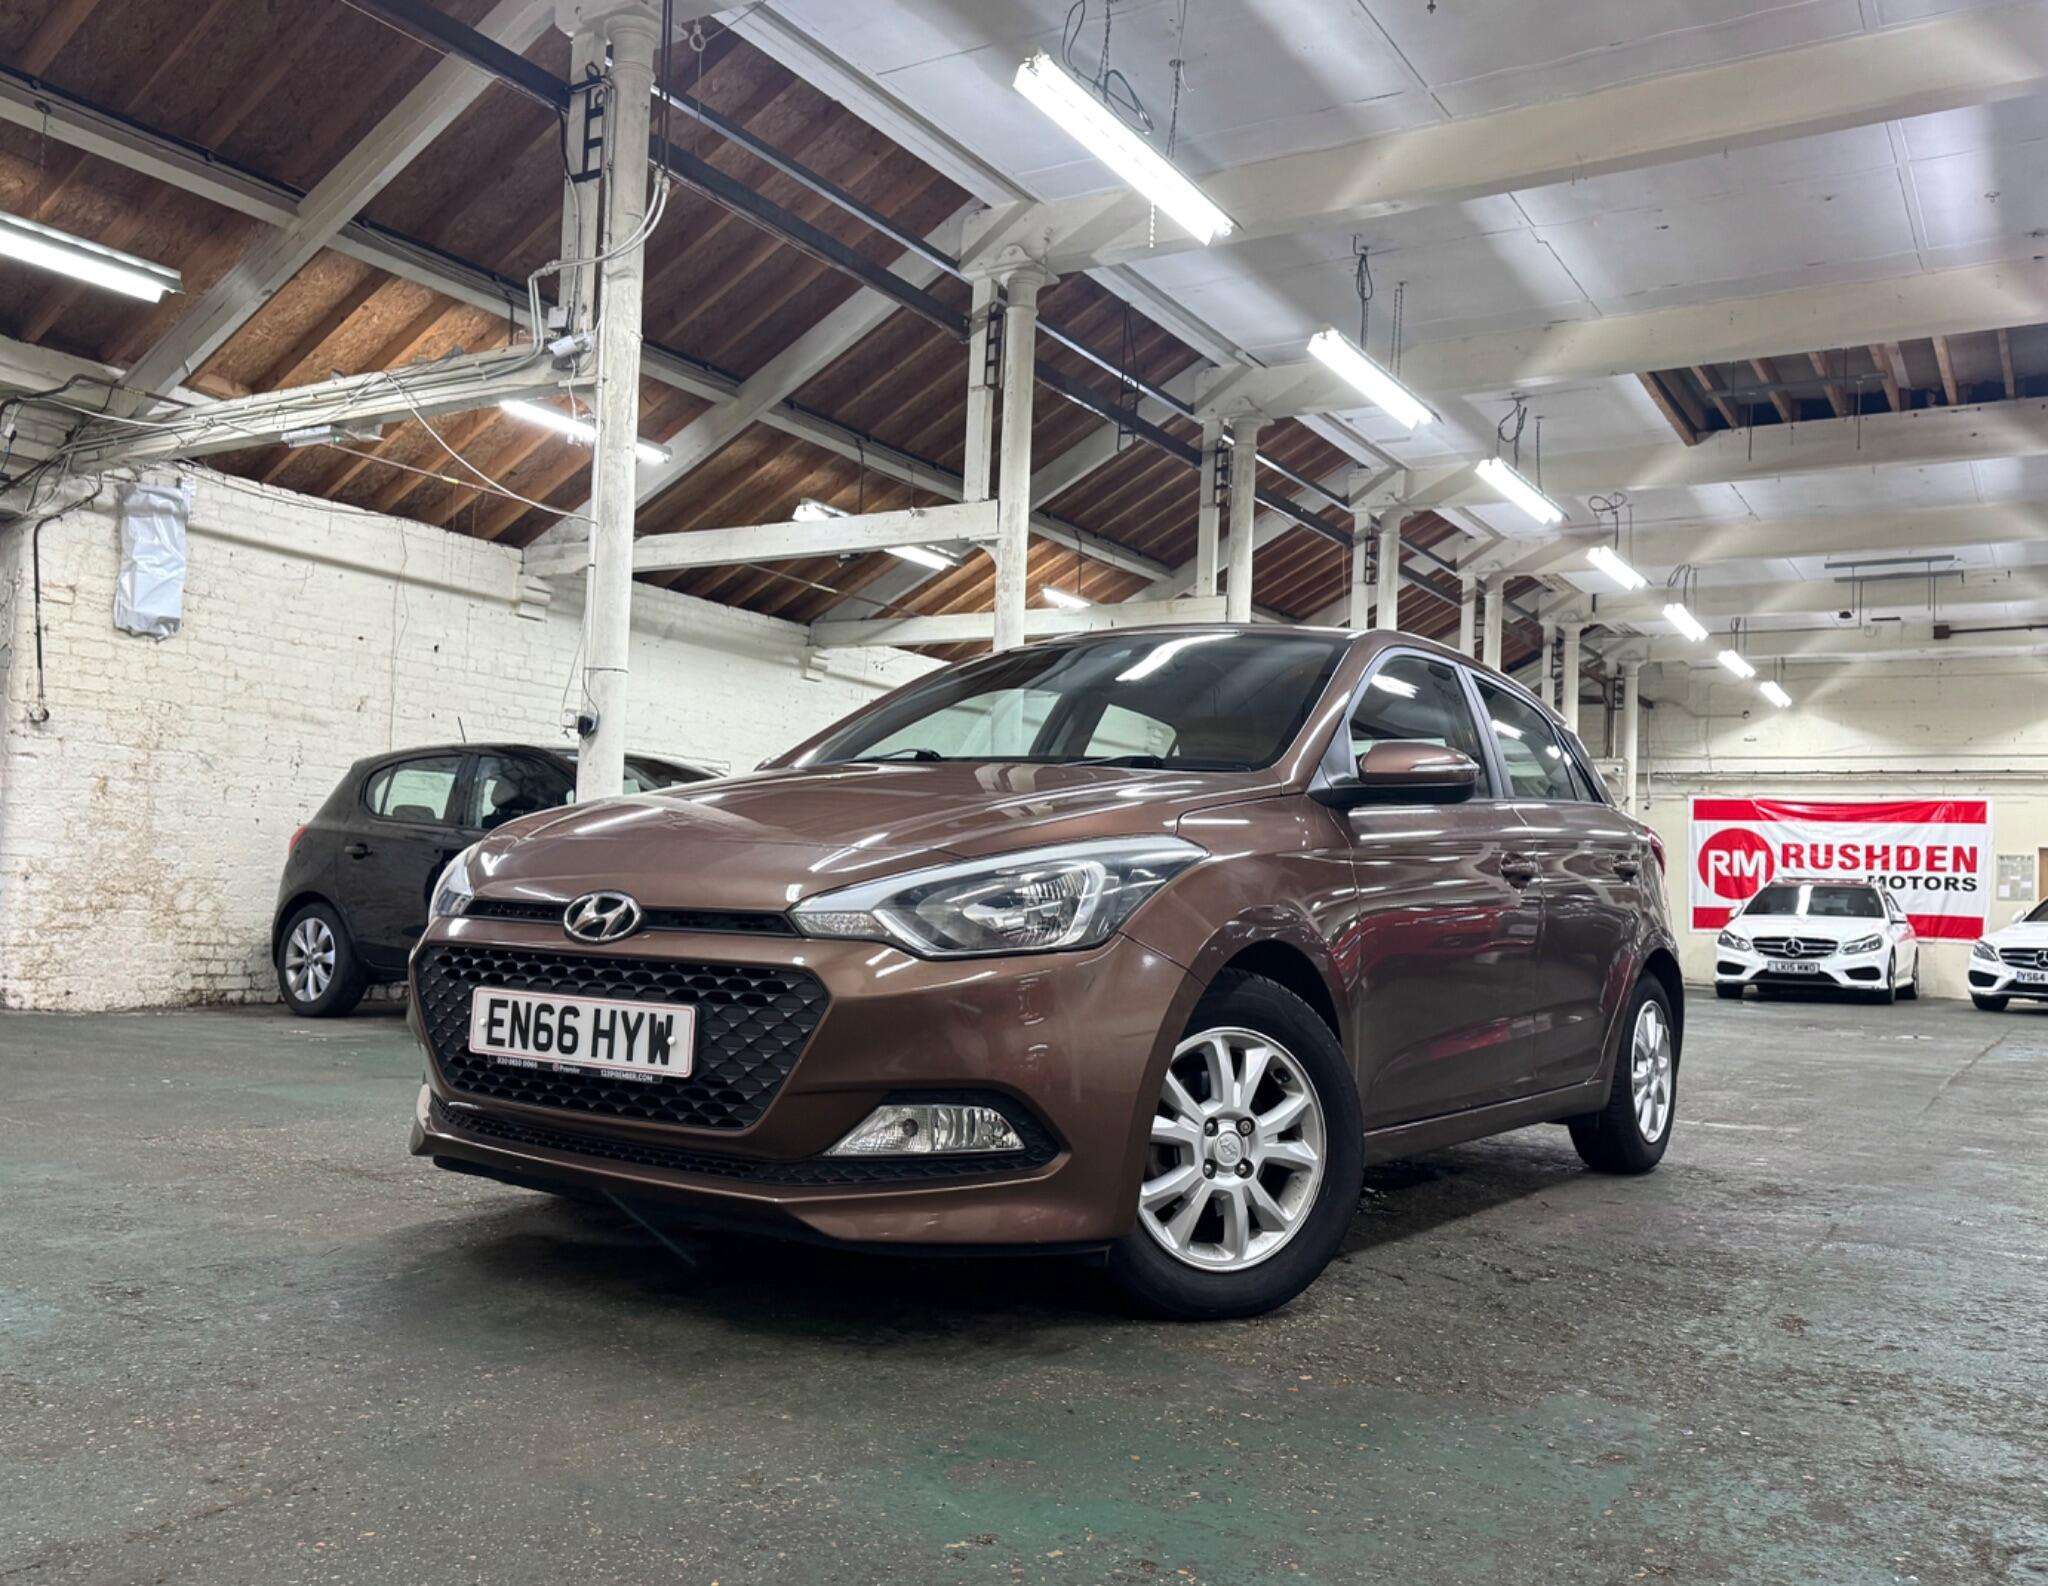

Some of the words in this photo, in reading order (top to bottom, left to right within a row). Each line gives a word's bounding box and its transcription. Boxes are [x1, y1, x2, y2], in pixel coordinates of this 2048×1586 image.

[1781, 843, 1978, 873] RUSHDEN
[486, 998, 580, 1055] EN66
[590, 1008, 675, 1065] HYW
